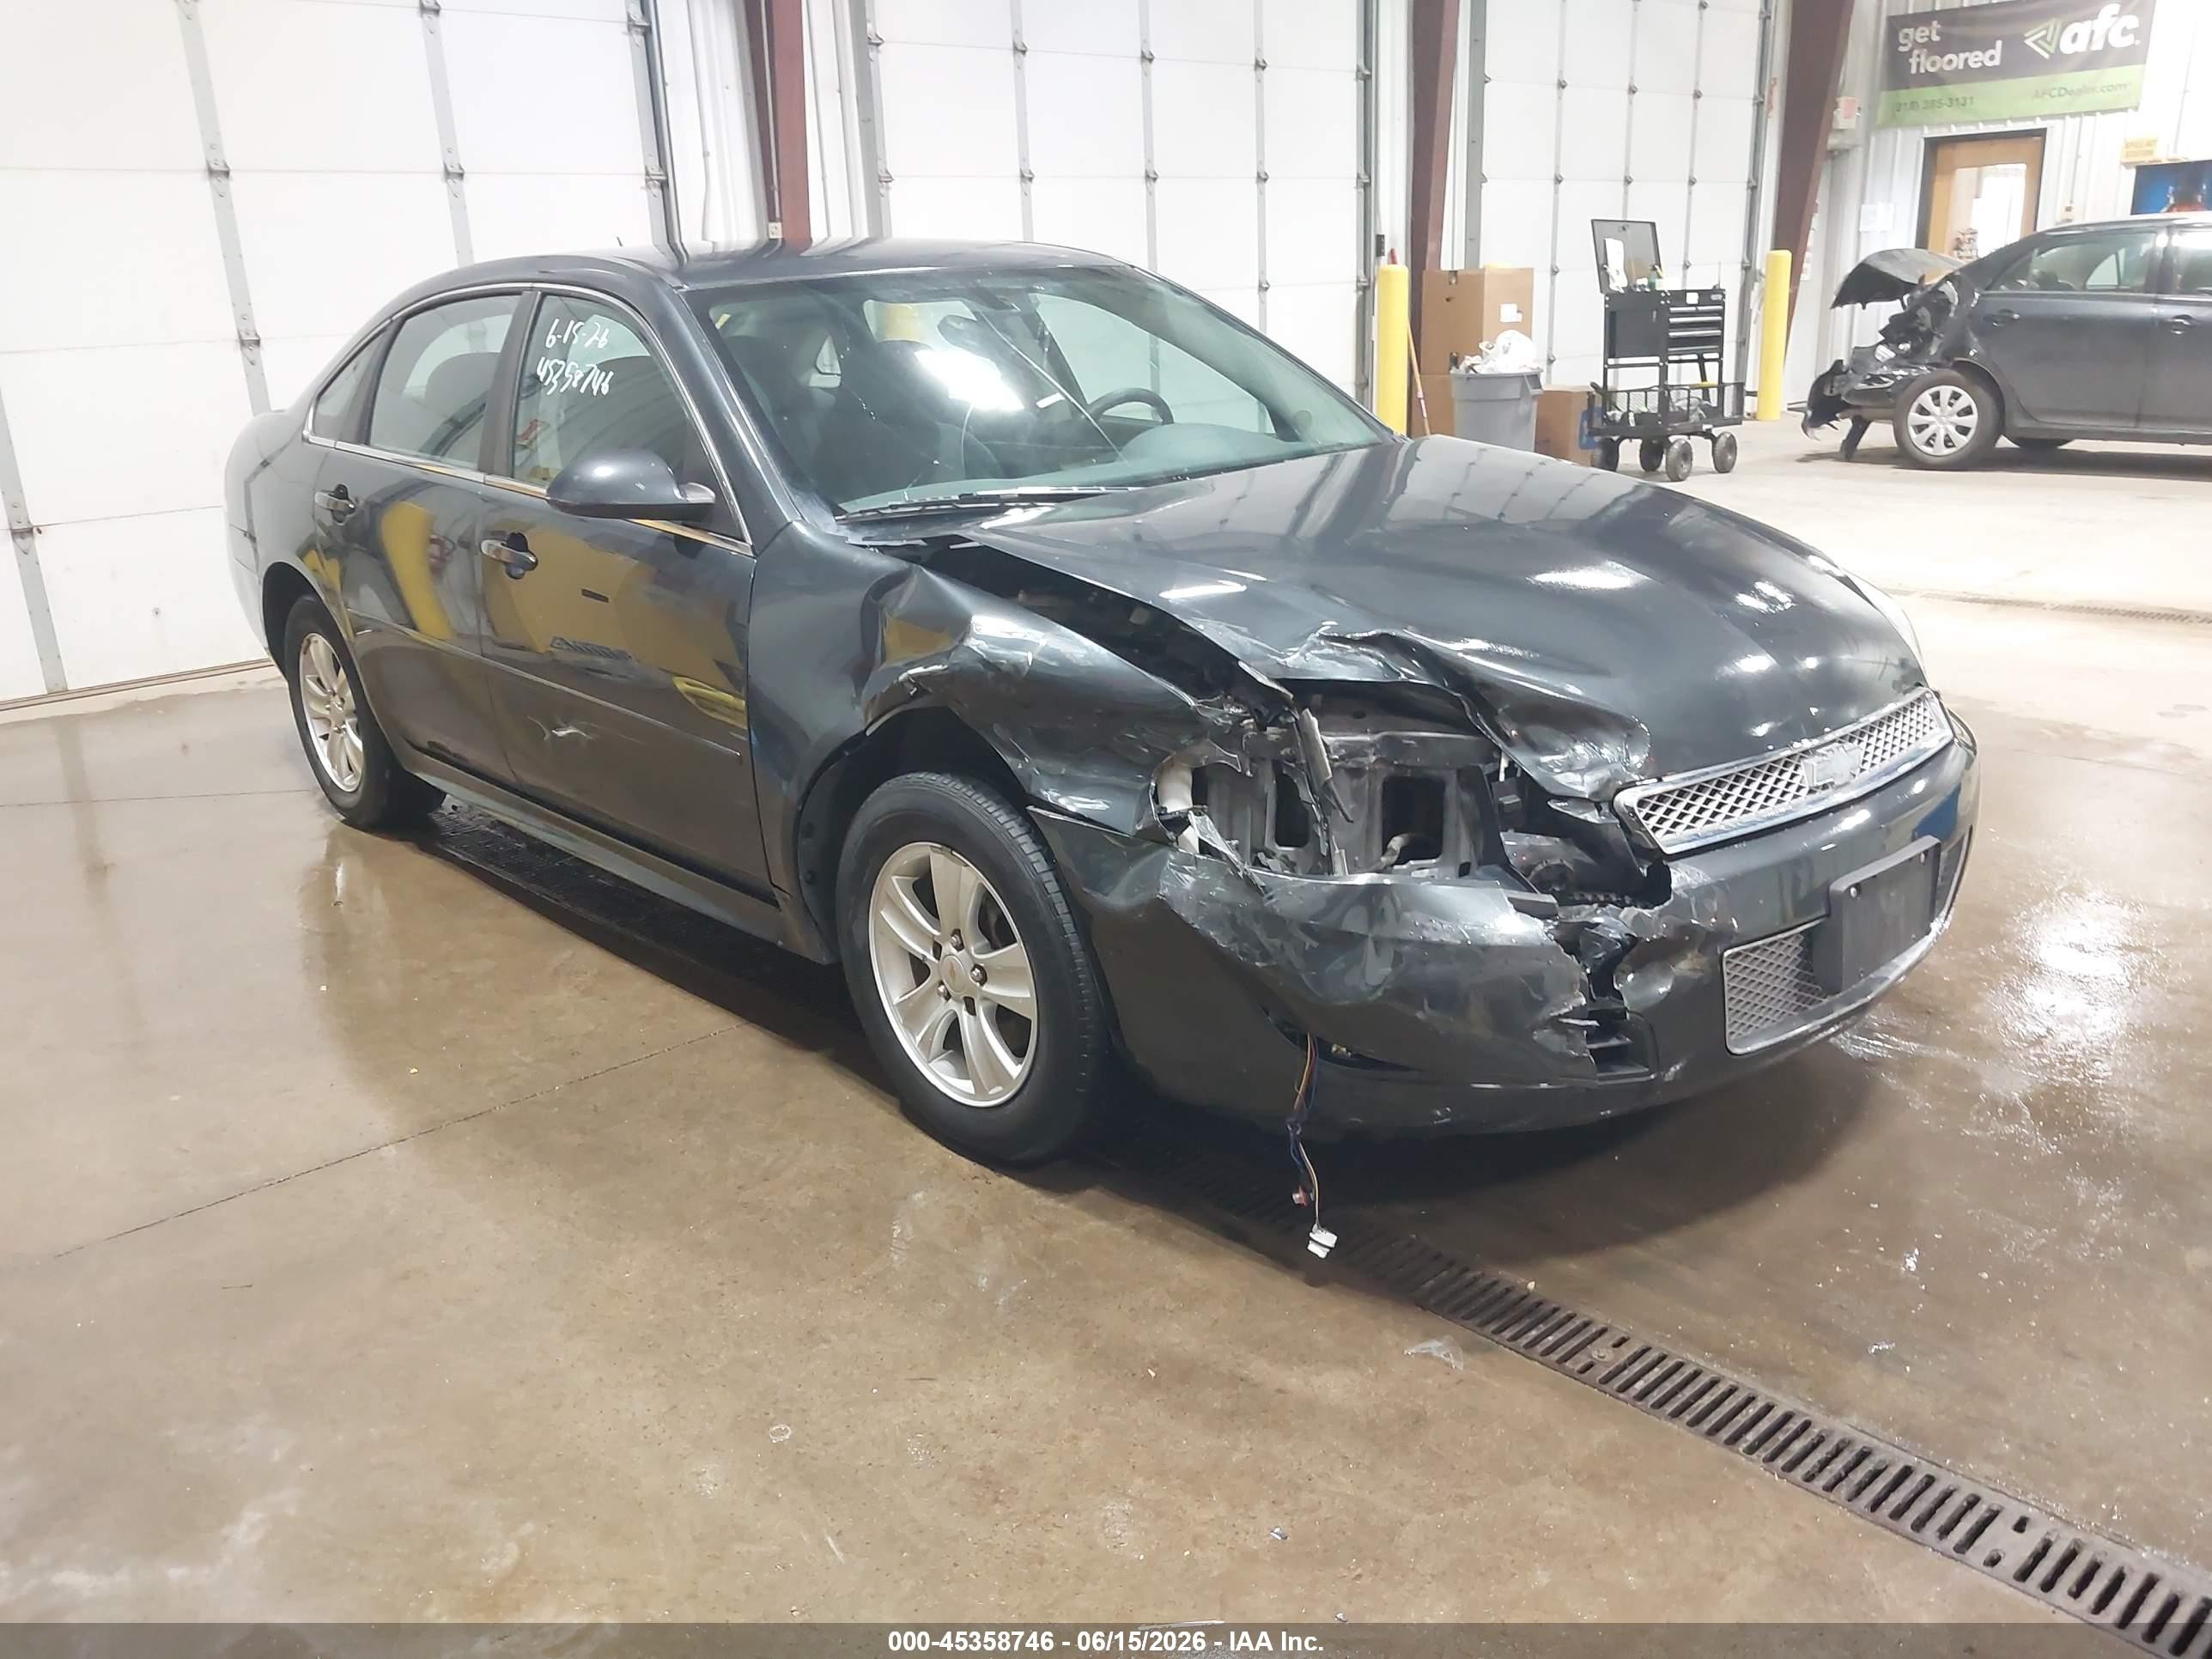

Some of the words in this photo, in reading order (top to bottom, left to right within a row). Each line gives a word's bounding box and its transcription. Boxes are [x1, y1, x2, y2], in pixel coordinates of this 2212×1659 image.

[1898, 21, 1941, 52] get
[1909, 40, 2002, 74] floored
[545, 318, 611, 349] 6-15-26
[536, 356, 615, 396] 45358746
